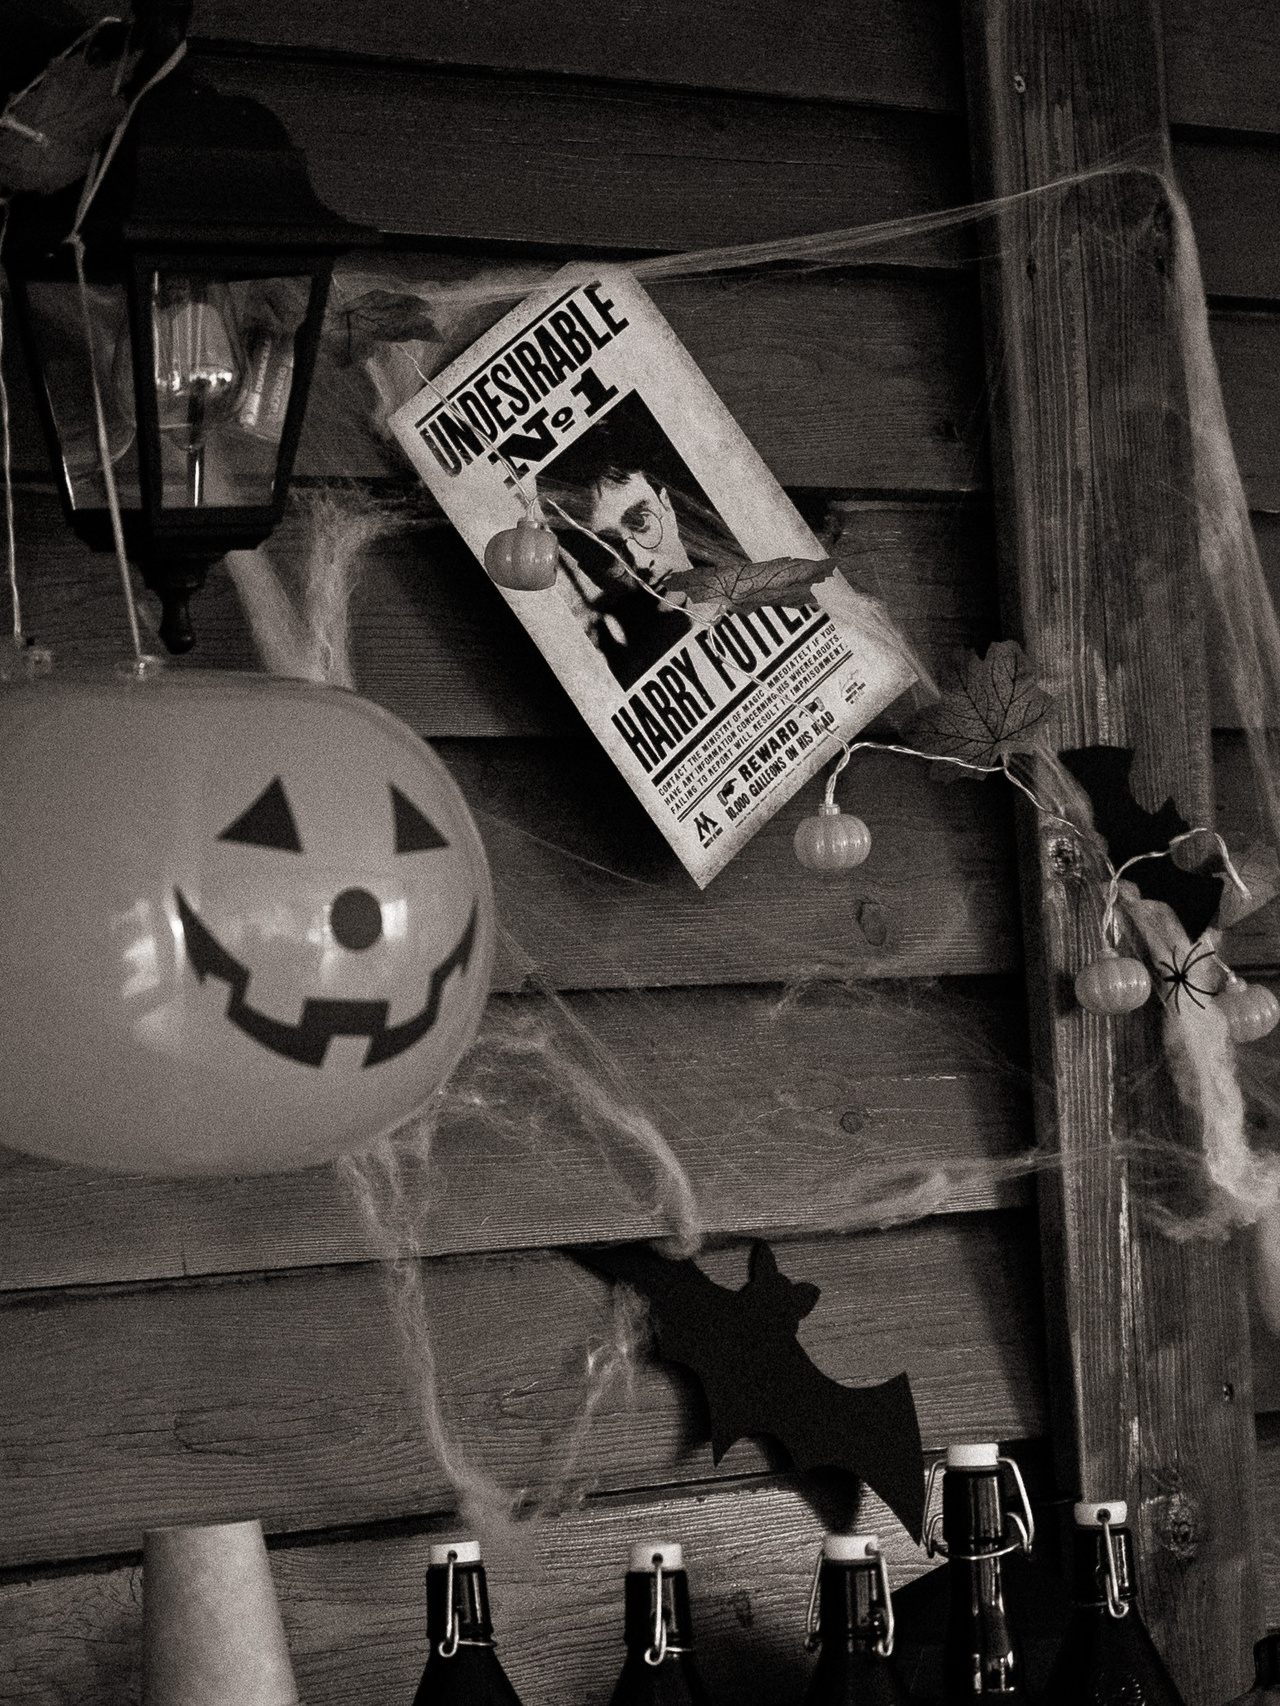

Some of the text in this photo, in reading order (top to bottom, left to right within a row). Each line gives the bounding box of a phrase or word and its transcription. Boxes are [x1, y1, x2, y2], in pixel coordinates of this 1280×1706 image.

[418, 278, 630, 477] UNDESIRABLE
[569, 366, 619, 418] 1
[609, 600, 822, 774] HARRY POTT
[657, 622, 836, 797] CONTACT THE MINISTRY OF MAGIC MMEDIATELY IF YOU
[663, 784, 682, 806] HAVE
[680, 770, 696, 788] ANY
[693, 729, 738, 775] INFORMATION
[735, 691, 778, 734] CONCERNING
[775, 679, 791, 695] HIS
[669, 784, 698, 815] FAILING
[697, 773, 709, 787] TO
[707, 747, 735, 777] REPORT
[733, 729, 753, 751] WILL
[752, 702, 781, 732] RESULT
[736, 716, 801, 783] REWARD
[746, 754, 788, 798] GALLEONS
[783, 743, 799, 762] ON
[795, 729, 814, 751] HIS
